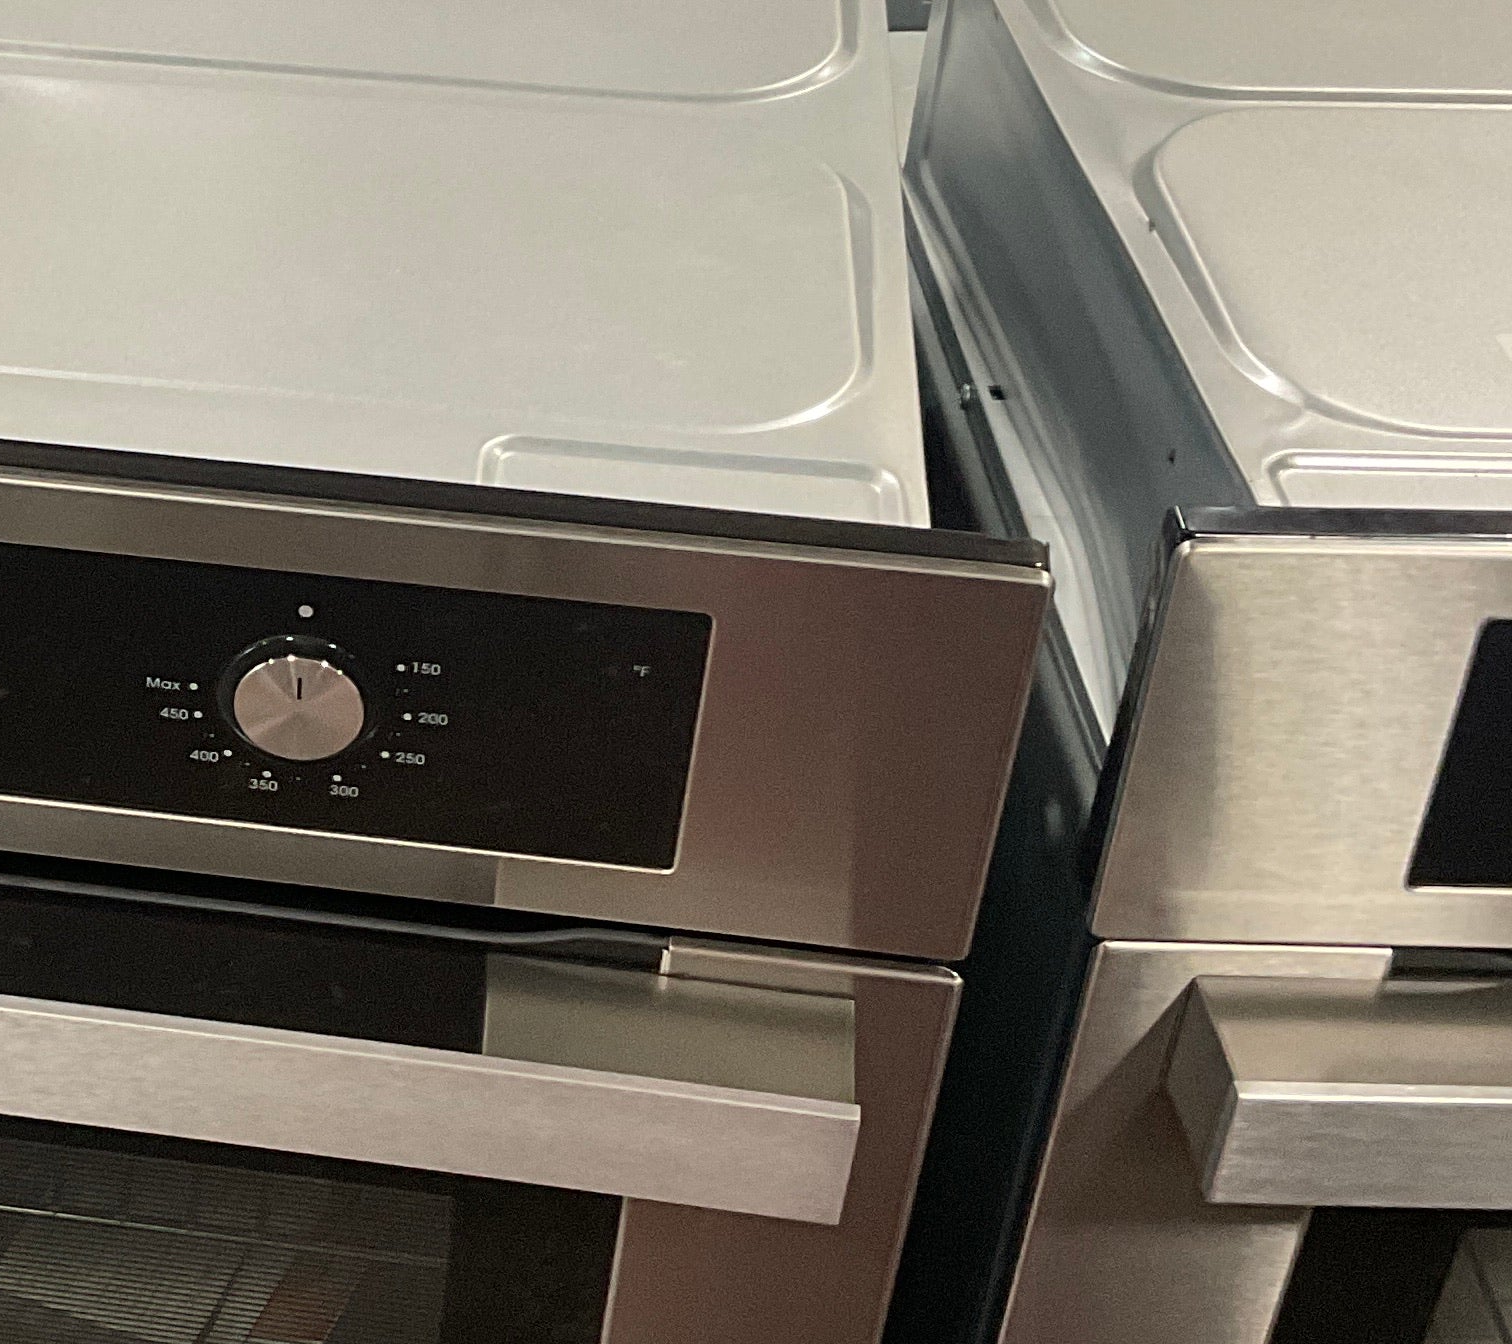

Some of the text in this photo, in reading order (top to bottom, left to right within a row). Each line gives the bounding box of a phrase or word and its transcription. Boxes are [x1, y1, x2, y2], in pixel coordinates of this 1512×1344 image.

[412, 661, 441, 676] 150
[633, 665, 650, 677] °F
[146, 675, 181, 691] Max
[160, 707, 189, 720] 450
[418, 712, 448, 726] 200
[190, 750, 219, 763] 400
[395, 751, 425, 765] 250
[248, 778, 278, 792] 350
[329, 784, 359, 798] 300
